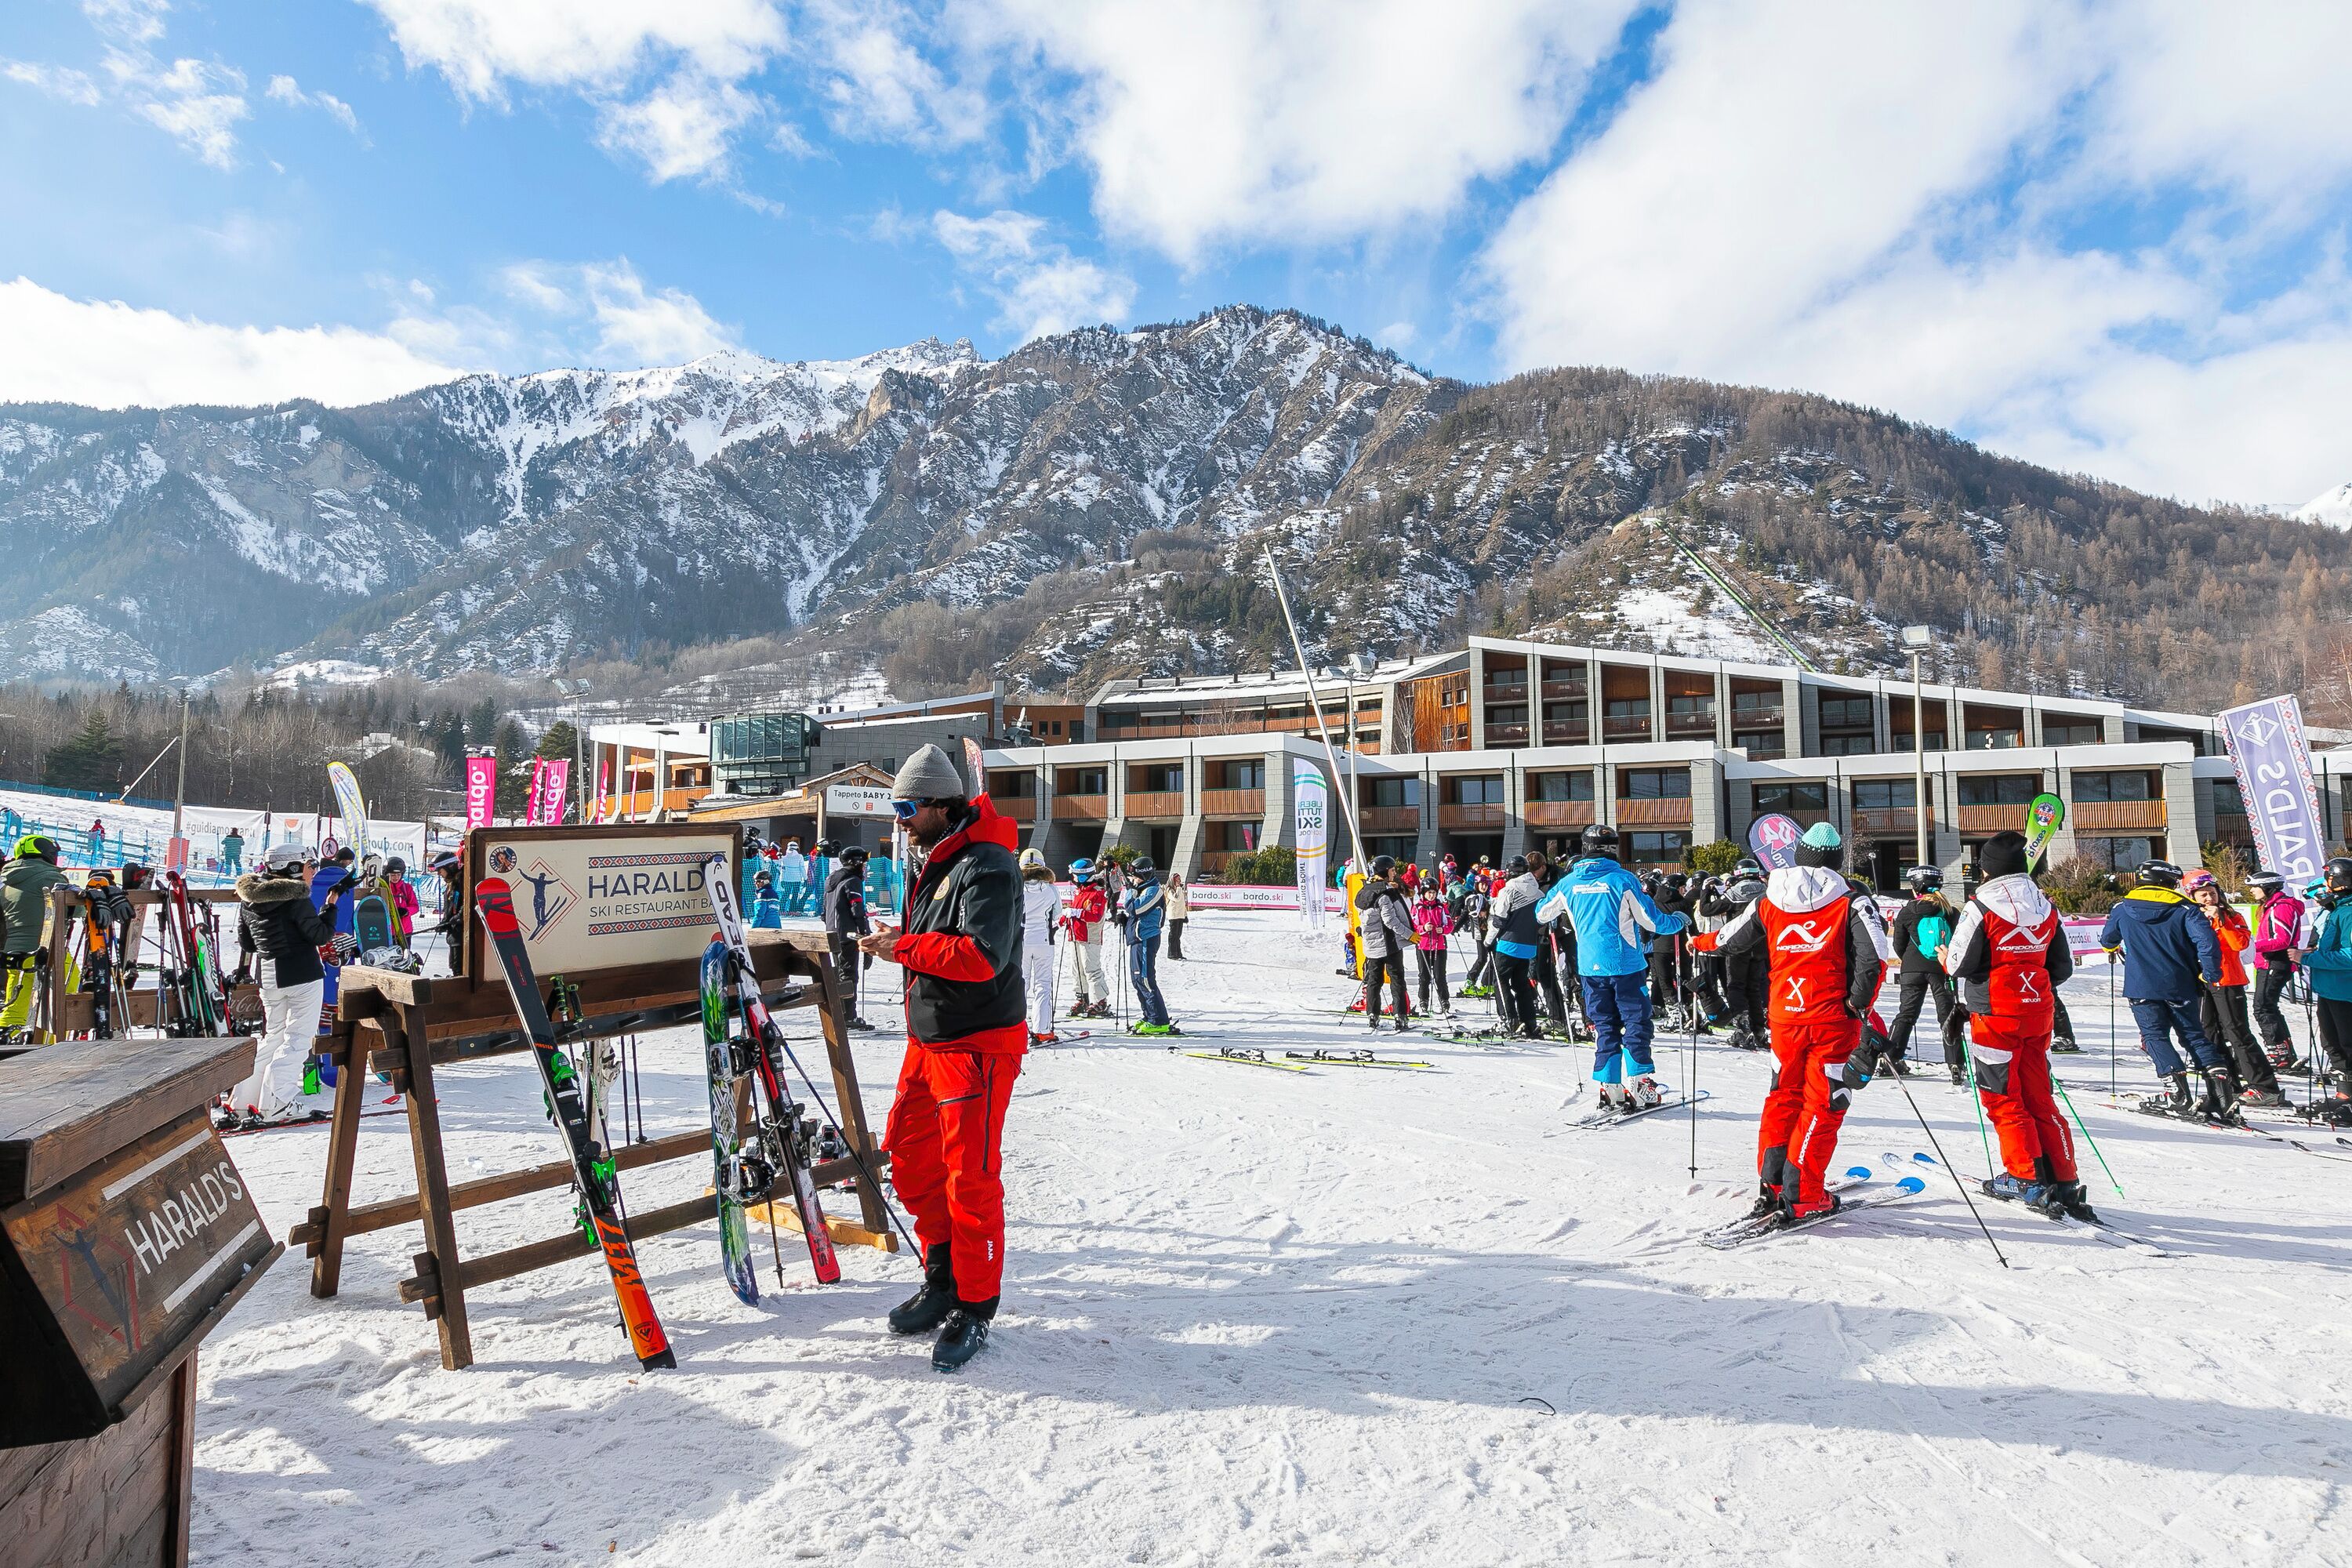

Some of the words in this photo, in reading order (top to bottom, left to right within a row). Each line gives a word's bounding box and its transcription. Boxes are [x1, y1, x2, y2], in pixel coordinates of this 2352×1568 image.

[833, 789, 862, 799] Tappeto
[862, 791, 885, 800] BABY
[588, 869, 706, 900] HARALD
[1192, 891, 1232, 900] bardo.ski
[1243, 891, 1284, 901] bardo.ski
[589, 905, 612, 918] SKI
[615, 899, 698, 916] RESTAURANT
[124, 1161, 243, 1275] HARALD'S
